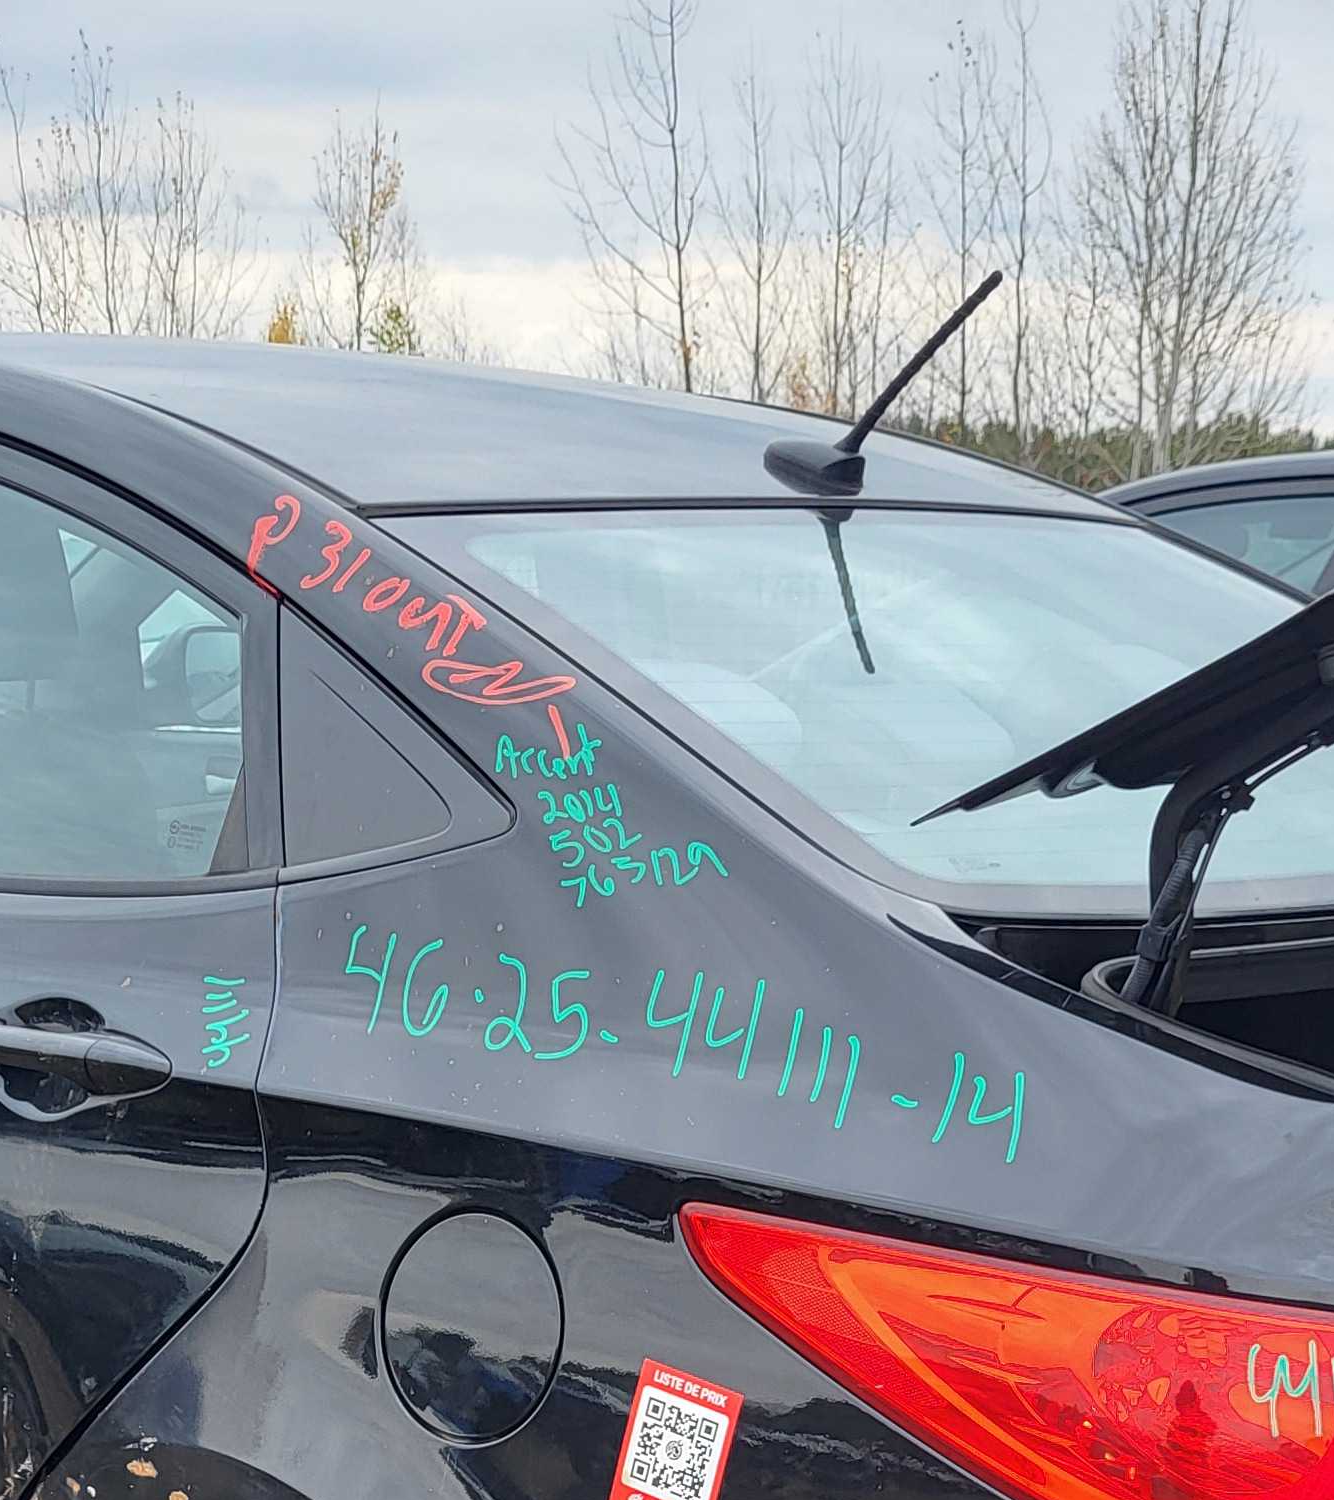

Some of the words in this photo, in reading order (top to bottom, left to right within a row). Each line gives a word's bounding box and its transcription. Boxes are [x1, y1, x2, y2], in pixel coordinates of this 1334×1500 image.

[538, 783, 623, 825] 2014
[549, 817, 643, 867] 502
[653, 1368, 685, 1391] LISTE
[683, 1381, 701, 1398] DE
[699, 1387, 728, 1409] PRIX
